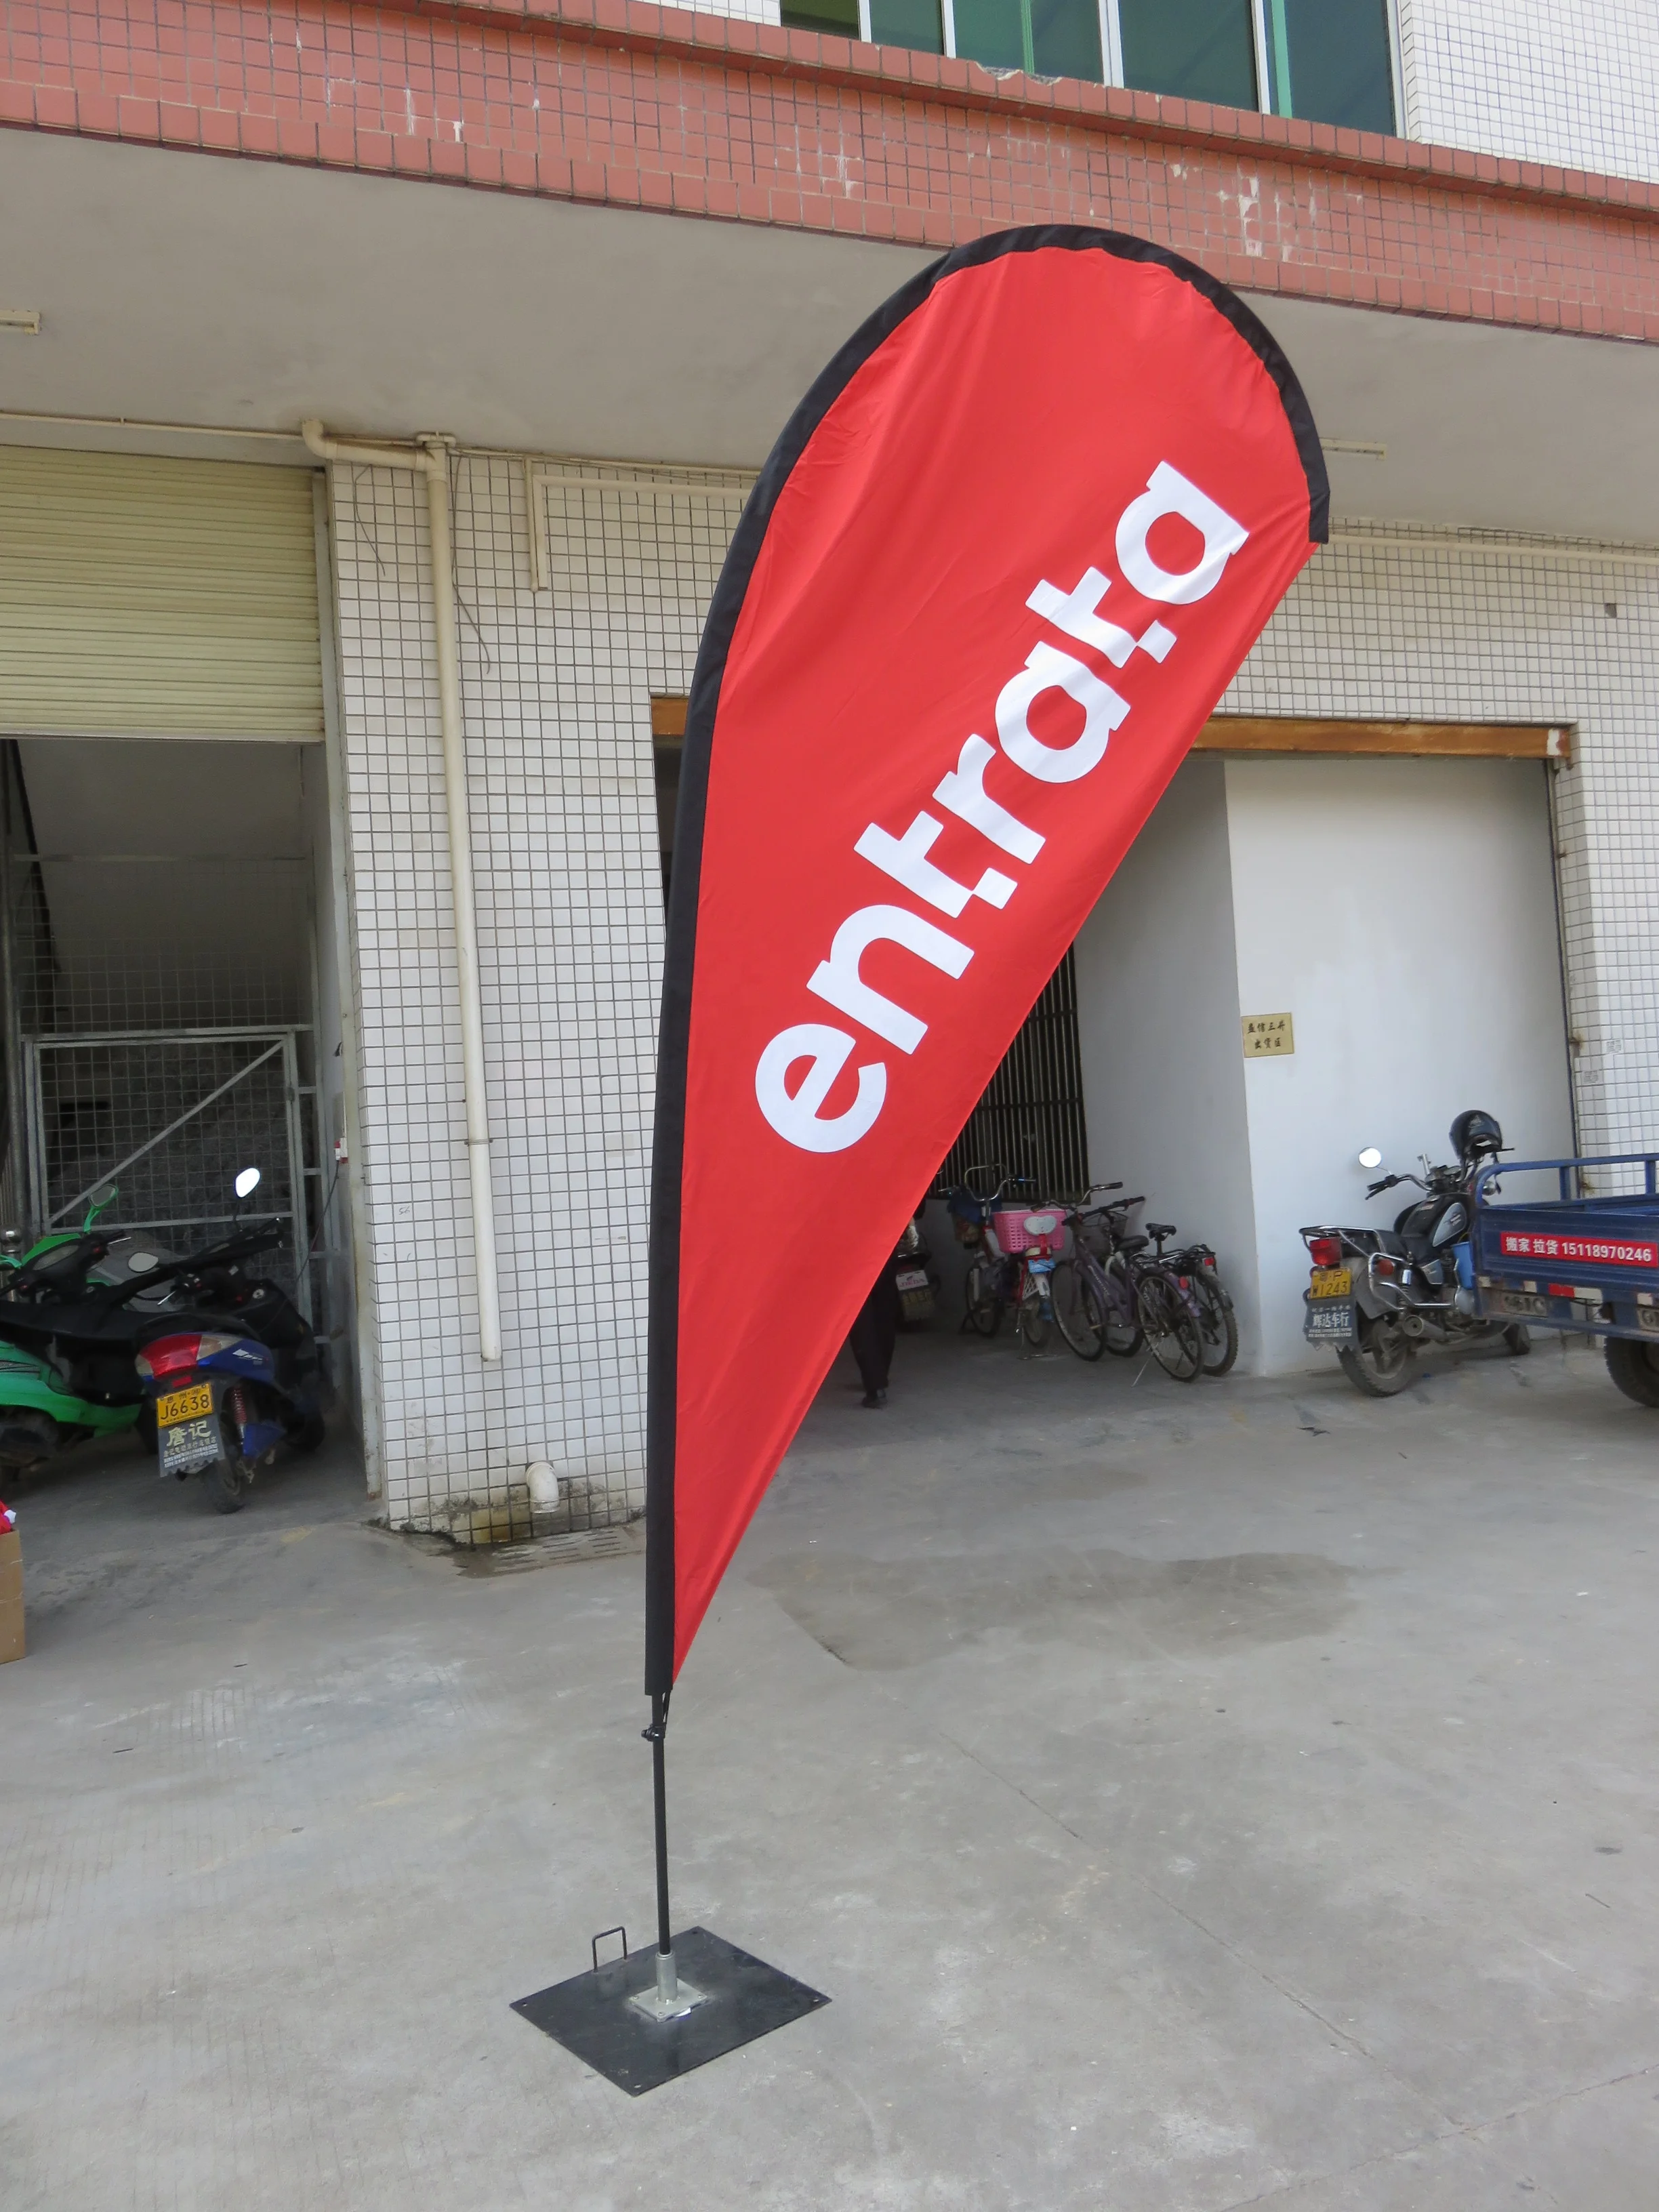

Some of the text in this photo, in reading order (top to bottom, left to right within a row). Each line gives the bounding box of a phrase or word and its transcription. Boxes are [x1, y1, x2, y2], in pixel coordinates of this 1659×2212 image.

[756, 461, 1249, 1153] entrata
[1505, 1237, 1652, 1262] 搬家 拉货 15118970246
[161, 1394, 209, 1420] J6638
[166, 1420, 211, 1447] 詹记
